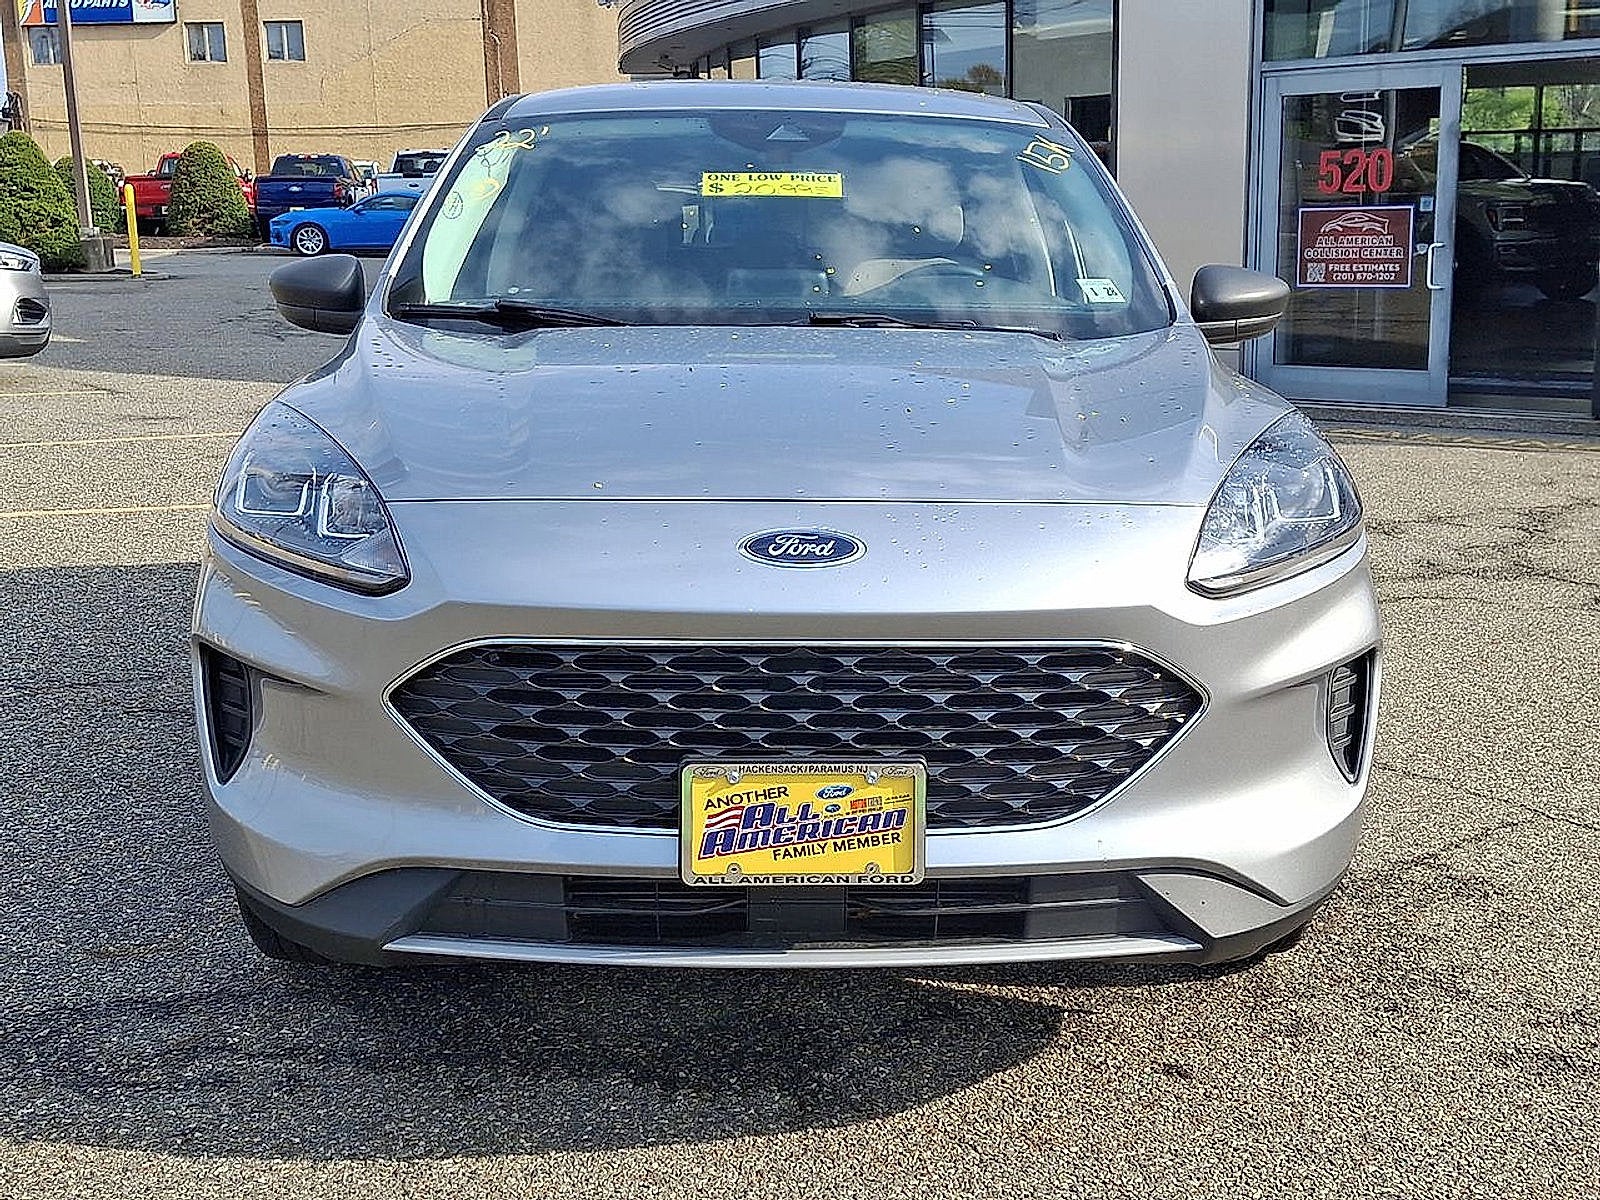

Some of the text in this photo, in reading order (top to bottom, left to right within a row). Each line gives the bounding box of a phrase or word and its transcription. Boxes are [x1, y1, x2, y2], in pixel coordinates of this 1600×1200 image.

[1319, 148, 1393, 193] 520
[707, 174, 838, 183] ONE LOW PRICE
[1316, 235, 1394, 247] ALL AMERICAN
[1304, 247, 1404, 258] COLLISION CENTER
[1329, 263, 1400, 272] FREE ESTIMATES
[768, 534, 835, 557] Ford
[738, 765, 868, 774] HACKENSACK/PARAMUS NJ
[704, 786, 789, 811] ANOTHER
[741, 802, 821, 831] ALL
[773, 831, 902, 861] FAMILY MEMBER
[693, 875, 914, 884] ALL AMERICAN FORD
